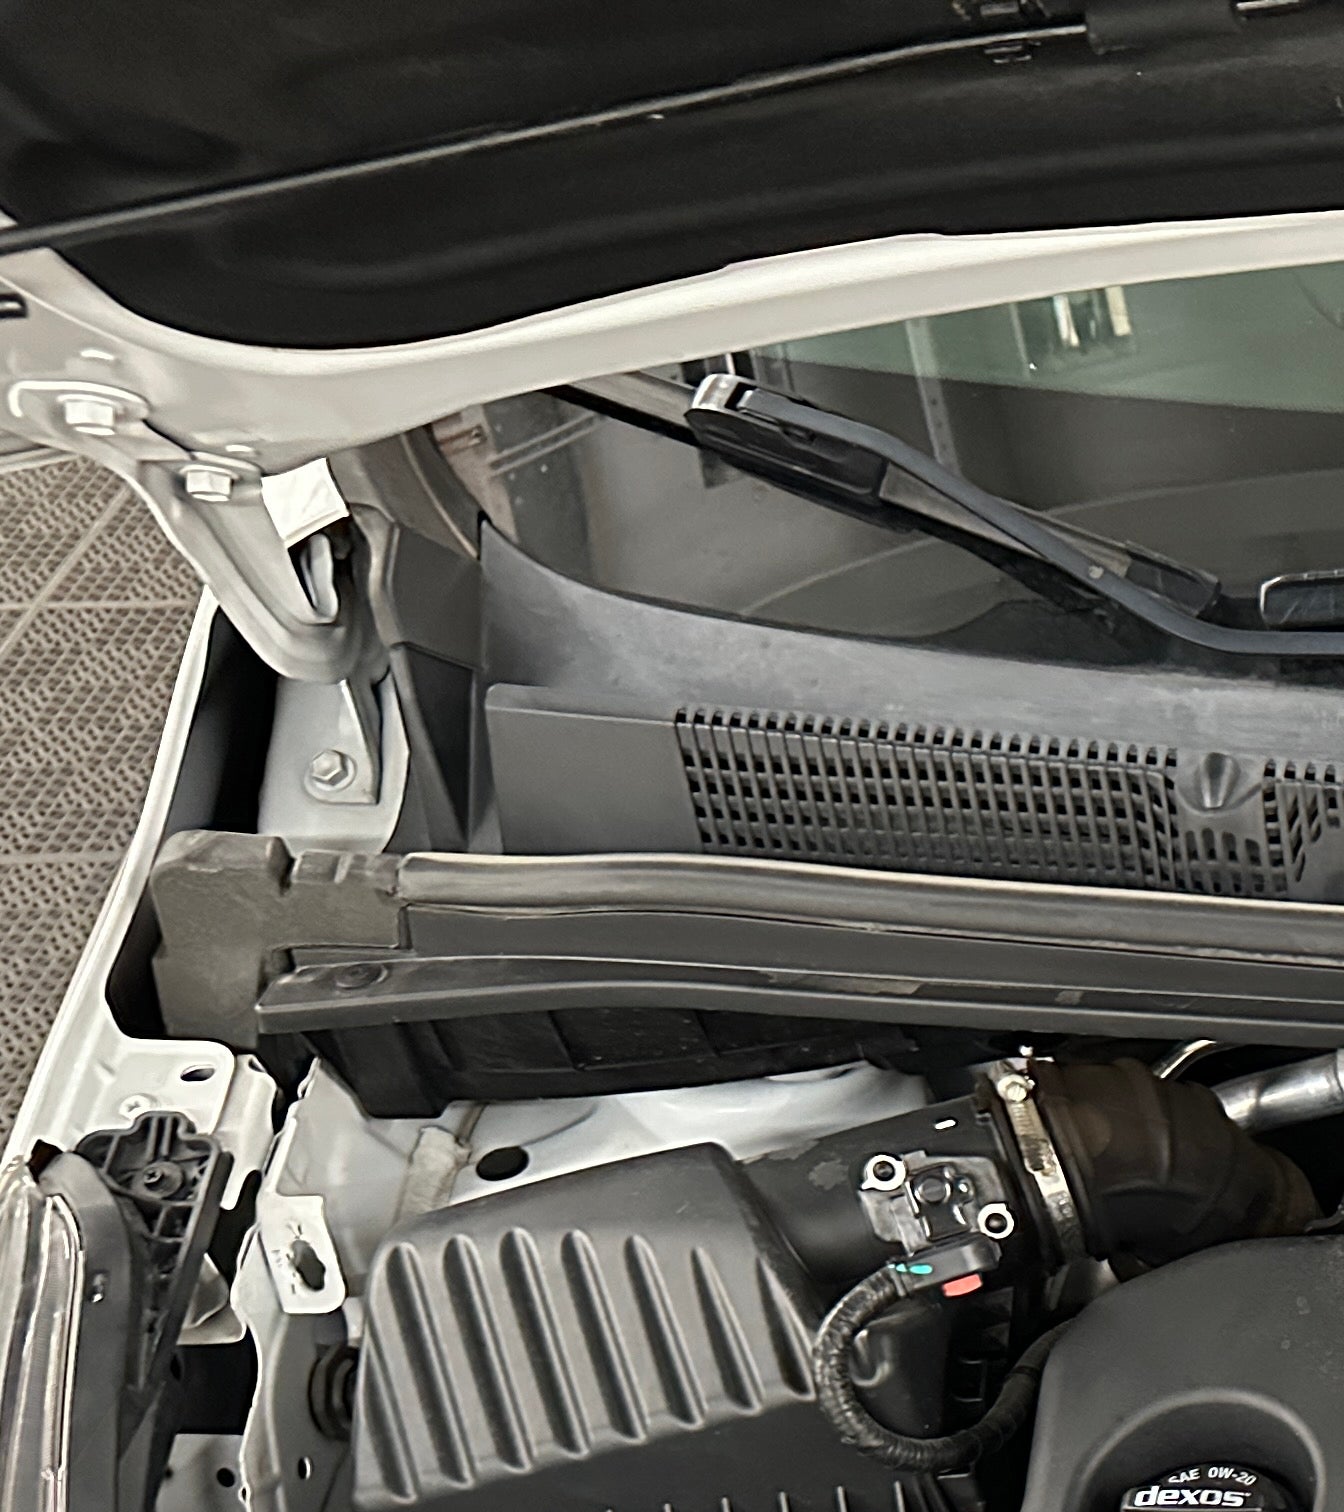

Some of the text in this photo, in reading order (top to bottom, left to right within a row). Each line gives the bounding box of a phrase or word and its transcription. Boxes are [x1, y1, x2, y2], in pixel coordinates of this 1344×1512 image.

[1167, 1465, 1258, 1486] SAE 0W-20
[1134, 1485, 1248, 1508] dexos
